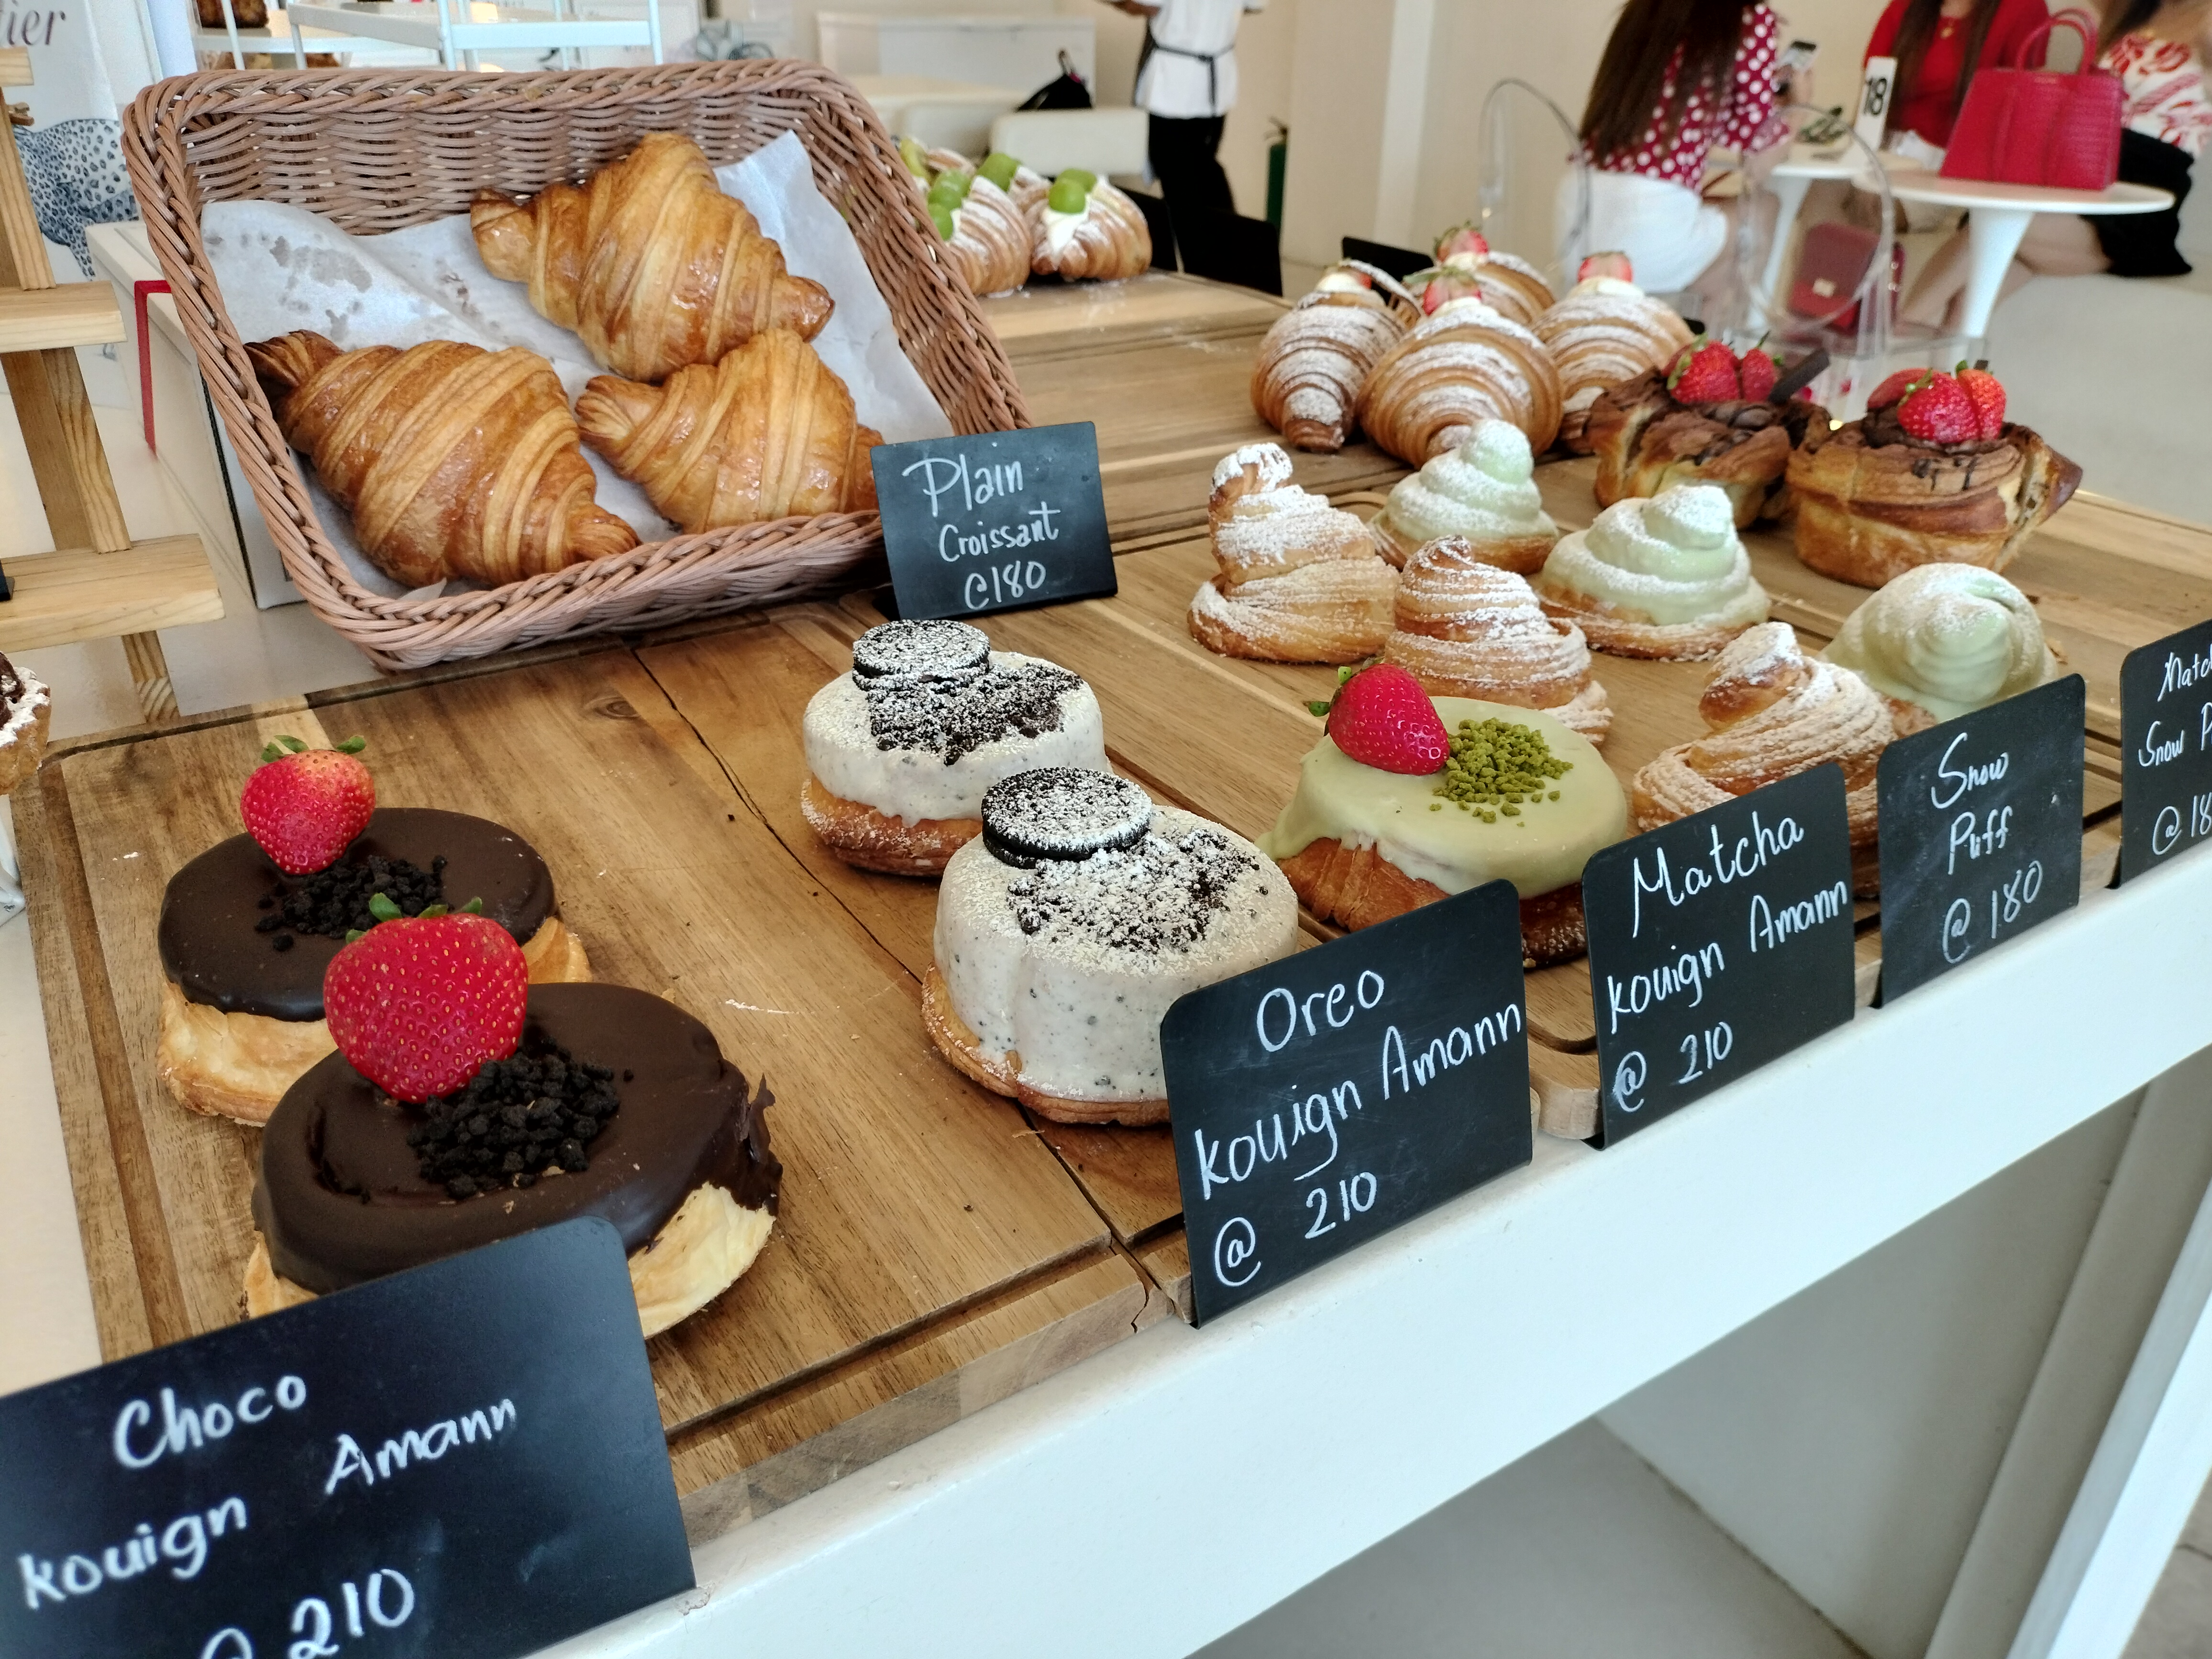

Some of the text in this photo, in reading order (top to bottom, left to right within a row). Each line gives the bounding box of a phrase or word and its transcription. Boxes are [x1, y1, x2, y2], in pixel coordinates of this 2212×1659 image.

[0, 0, 66, 45] ier
[1864, 77, 1887, 115] 18
[902, 443, 1023, 517] Plain
[939, 500, 1061, 562] Croissant
[1931, 732, 2009, 809] Snow
[2138, 720, 2185, 767] Snow
[1947, 805, 2013, 875] Puff
[2153, 806, 2182, 855] @
[1633, 811, 1805, 938] Matcha
[1942, 861, 2043, 963] @ 180
[1607, 881, 1847, 1034] kouign Amann
[1256, 970, 1385, 1053] Oreo
[1194, 1003, 1521, 1200] kouign Amann
[1613, 1022, 1734, 1112] @ 210
[1214, 1171, 1377, 1287] @ 210
[113, 1374, 307, 1470] Choco
[18, 1398, 517, 1611] kouign Amann
[288, 1568, 415, 1659] 210
